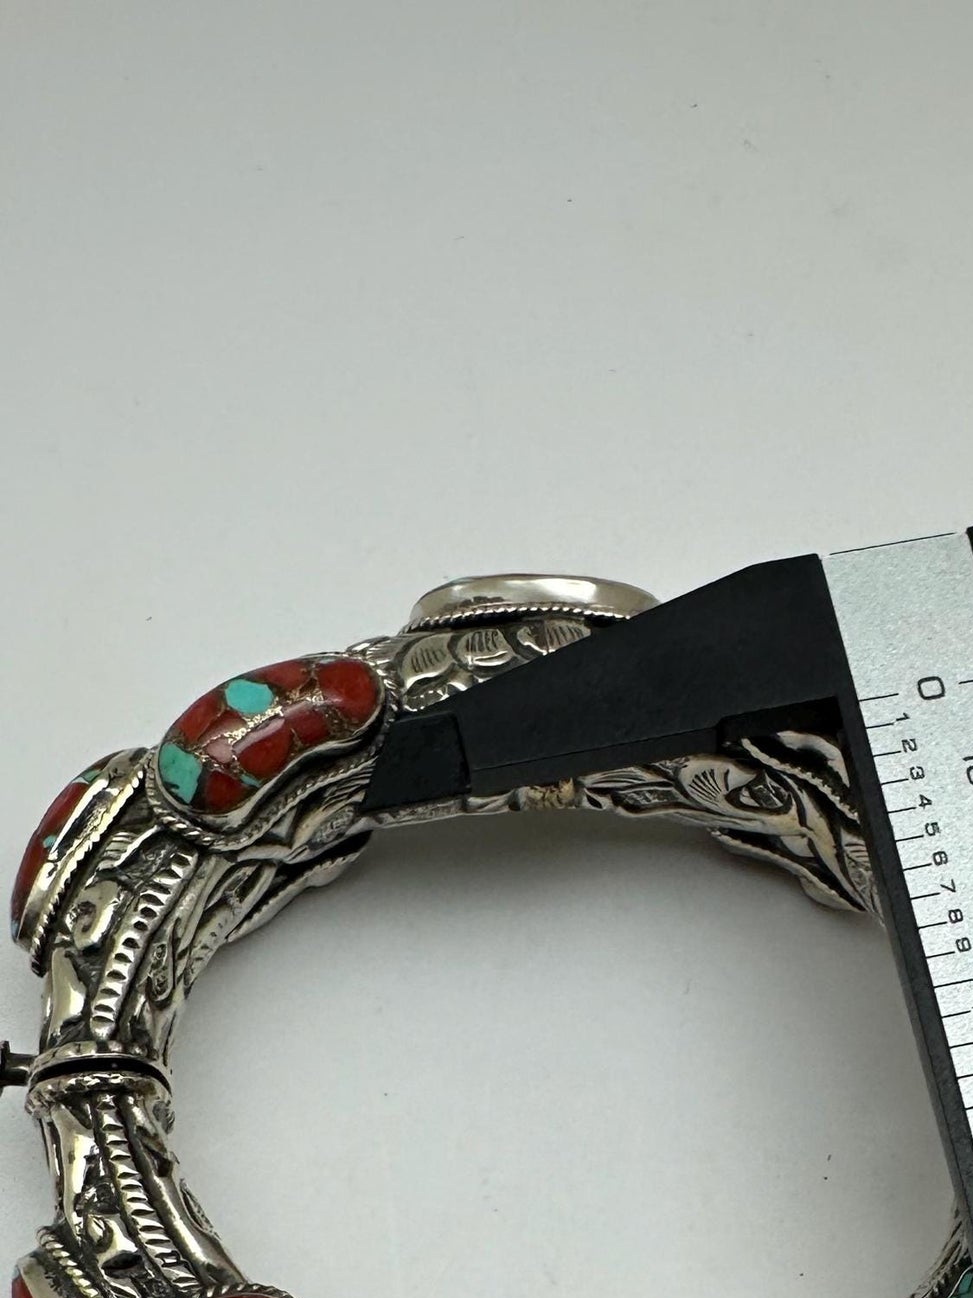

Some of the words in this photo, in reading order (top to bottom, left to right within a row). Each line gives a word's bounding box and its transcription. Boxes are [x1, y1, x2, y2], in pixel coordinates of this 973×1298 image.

[917, 676, 945, 700] 0
[896, 712, 910, 722] 1
[901, 738, 917, 753] 2
[910, 766, 925, 780] 3
[918, 794, 932, 809] 4
[925, 822, 940, 836] 5
[933, 851, 948, 865] 6
[940, 879, 956, 892] 7
[948, 909, 964, 924] 8
[955, 937, 972, 952] 9
